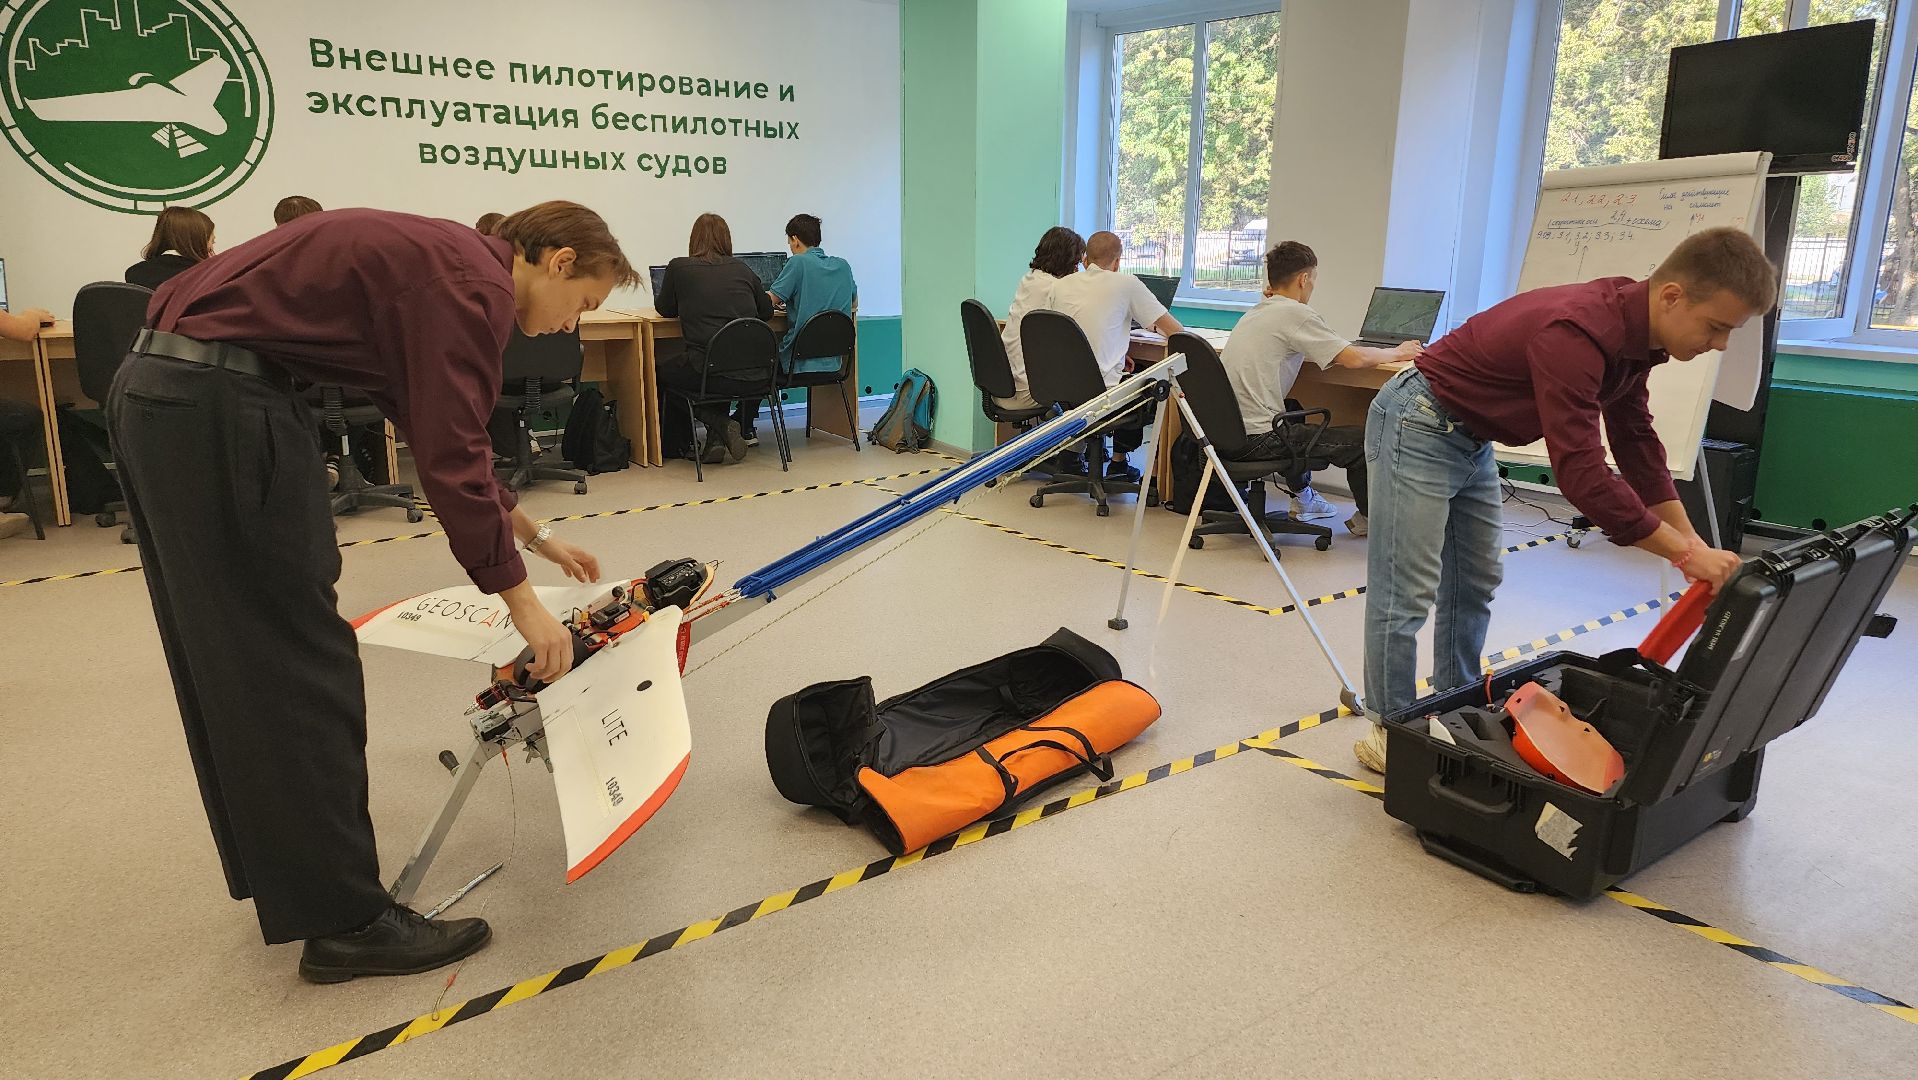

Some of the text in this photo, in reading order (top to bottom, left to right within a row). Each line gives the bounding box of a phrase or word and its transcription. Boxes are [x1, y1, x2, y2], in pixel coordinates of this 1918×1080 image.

[309, 38, 796, 102] Внешнее пилотирование и
[306, 88, 800, 141] эксплуатация беспилотных
[418, 142, 728, 177] воздушных судов
[397, 611, 422, 622] 10349
[416, 597, 514, 630] GEOSCAN
[601, 708, 628, 746] LITE
[605, 776, 624, 807] 10349
